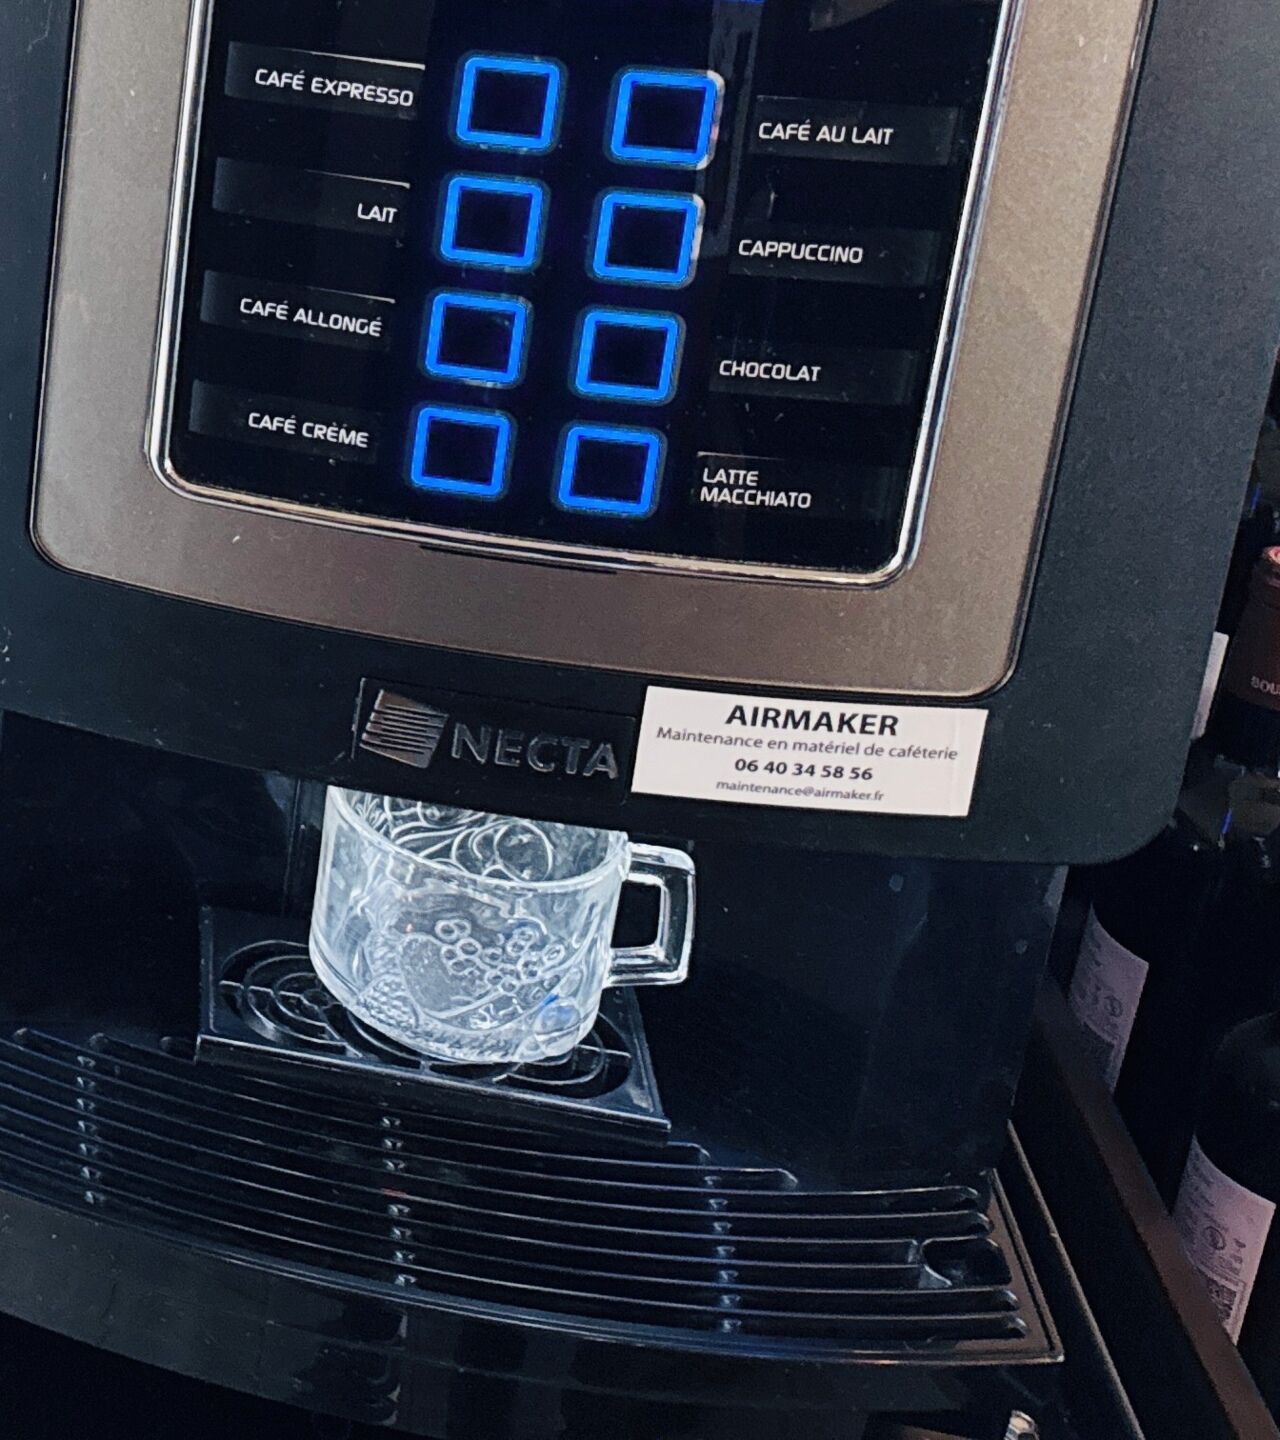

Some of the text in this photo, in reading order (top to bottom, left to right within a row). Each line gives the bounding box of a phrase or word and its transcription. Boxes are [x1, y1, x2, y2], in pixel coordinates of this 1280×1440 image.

[255, 68, 414, 107] CAFÉ EXPRESSO
[758, 119, 895, 146] CAFÉ AU LAIT
[357, 203, 398, 224] LAIT
[738, 240, 863, 264] CAPPUCCINO
[240, 298, 382, 337] CAFÉ ALLONGÉ
[719, 360, 821, 382] CHOCOLAT
[248, 412, 297, 435] CAFÉ
[702, 468, 759, 488] LATTE
[699, 489, 812, 509] MACCHIATO
[725, 704, 900, 737] AIRMAKER
[451, 722, 619, 780] NECTA
[656, 727, 958, 761] Maintenance en matériel de caféterie
[734, 758, 874, 782] 06 40 34 58 56
[715, 778, 885, 802] maintenance@airmaker.fr
